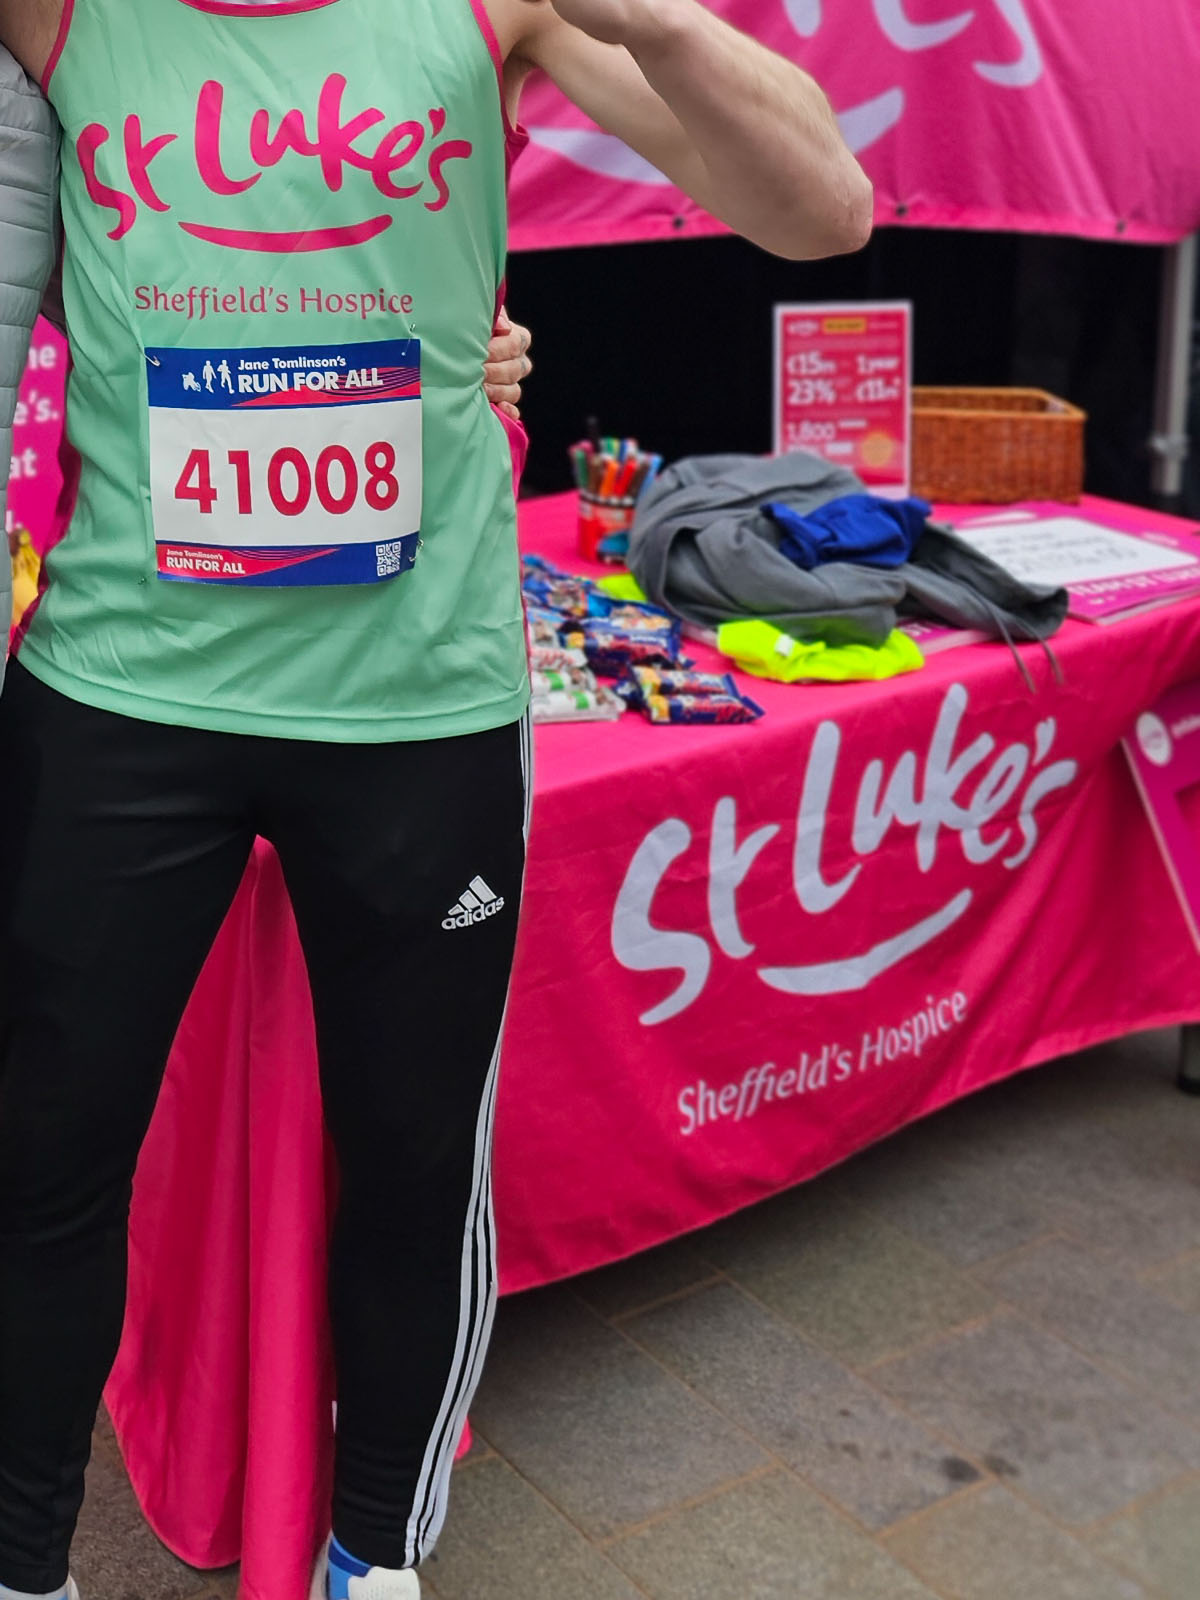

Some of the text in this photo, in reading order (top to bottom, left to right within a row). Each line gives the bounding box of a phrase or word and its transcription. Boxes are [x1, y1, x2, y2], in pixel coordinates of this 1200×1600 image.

[76, 72, 472, 240] St Luke's
[134, 285, 414, 320] Sheffield's Hospice
[237, 356, 347, 371] Jane Tomlinson's
[237, 367, 385, 393] RUN FOR ALL
[174, 441, 400, 516] 41008
[166, 557, 246, 575] RUN FOR ALL
[184, 550, 224, 561] Tomlinson's
[611, 682, 1078, 1027] St Luke's
[441, 896, 505, 930] adidas
[677, 991, 968, 1136] Sheffield's Hospice
